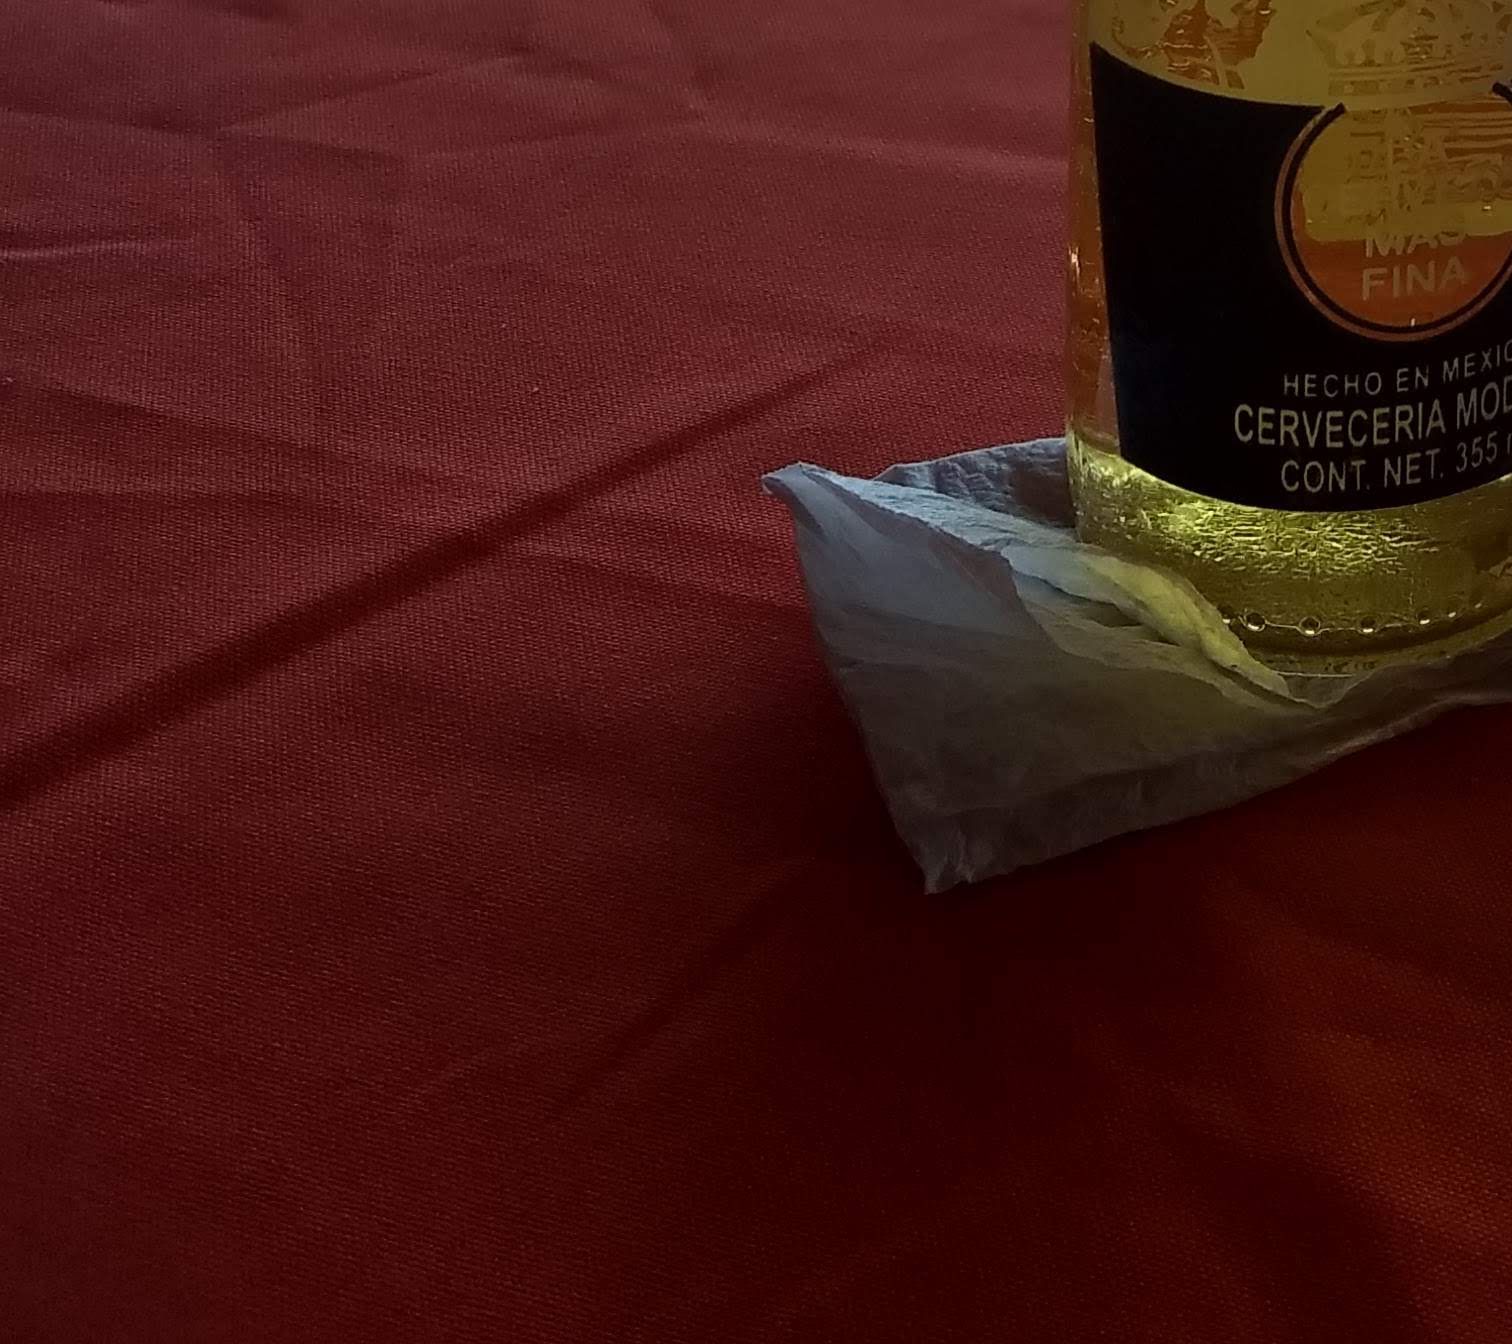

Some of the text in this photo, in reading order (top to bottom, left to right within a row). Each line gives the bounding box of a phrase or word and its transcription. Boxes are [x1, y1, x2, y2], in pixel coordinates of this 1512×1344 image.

[1362, 255, 1466, 302] FINA
[1283, 372, 1383, 398] HECHO
[1396, 365, 1430, 393] EN
[1234, 398, 1447, 448] CERVECERIA
[1281, 459, 1371, 493] CONT.
[1383, 447, 1445, 489] NET.
[1455, 430, 1499, 473] 355
